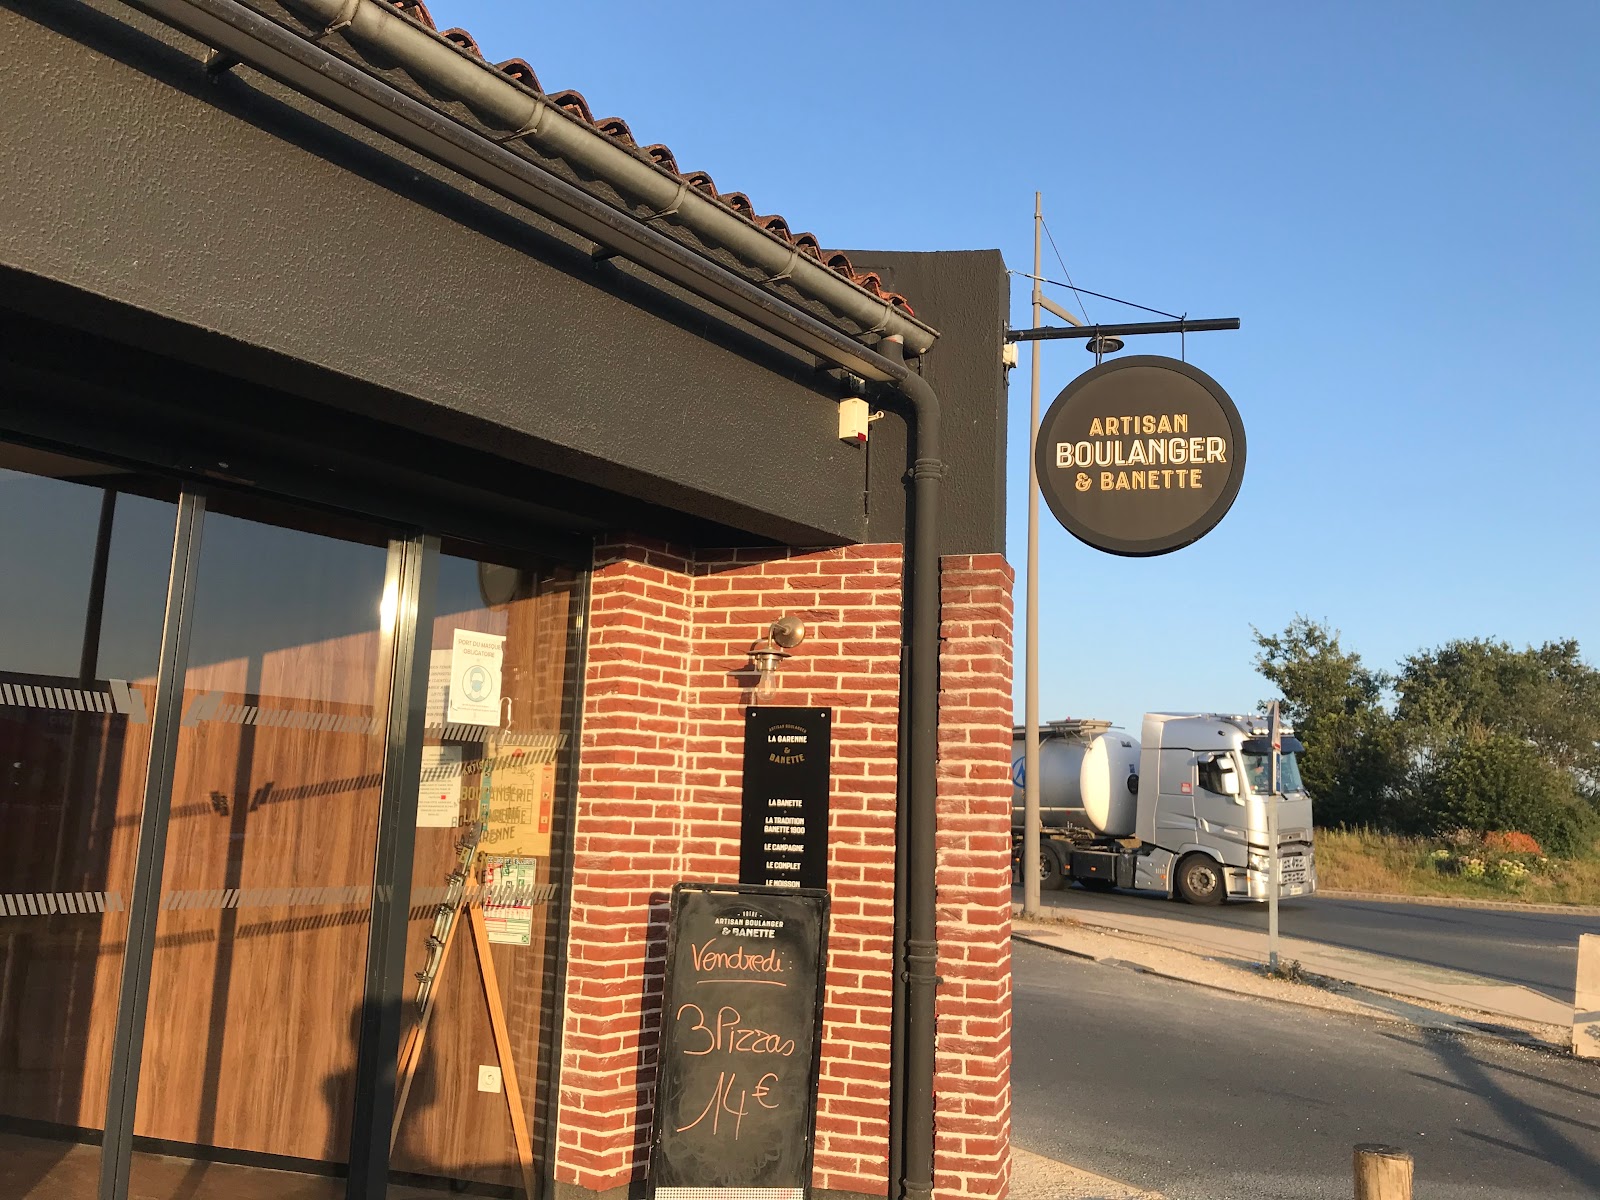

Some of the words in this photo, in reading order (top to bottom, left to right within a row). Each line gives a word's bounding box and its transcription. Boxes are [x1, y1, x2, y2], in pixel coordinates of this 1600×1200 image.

[1089, 413, 1188, 436] ARTISAN
[1056, 436, 1227, 468] BOULANGER
[1075, 472, 1092, 491] &
[1100, 469, 1203, 490] BANETTE
[458, 638, 472, 647] PORT
[472, 640, 481, 648] DU
[481, 642, 502, 650] MASQUE
[463, 648, 495, 658] OBLIGATOIRE
[767, 735, 777, 743] LA
[777, 735, 808, 743] GARENNE
[783, 746, 791, 754] &
[769, 753, 806, 764] BANETTE
[768, 799, 776, 807] LA
[777, 799, 802, 807] BANETTE
[765, 816, 773, 824] LA
[774, 817, 805, 825] TRADITION
[764, 825, 790, 833] BANETTE
[790, 826, 805, 834] 1900
[764, 843, 772, 851] LE
[772, 844, 805, 852] CAMPAGNE
[766, 861, 773, 869] LE
[774, 861, 801, 870] COMPLET
[765, 879, 773, 887] LE
[774, 880, 801, 888] MOISSON
[715, 917, 744, 926] ARTISAN
[744, 919, 784, 928] BOULANGER
[721, 926, 731, 936] &
[732, 927, 776, 939] BANETTE
[677, 1003, 715, 1056] 3
[716, 1006, 795, 1057] Pizzas
